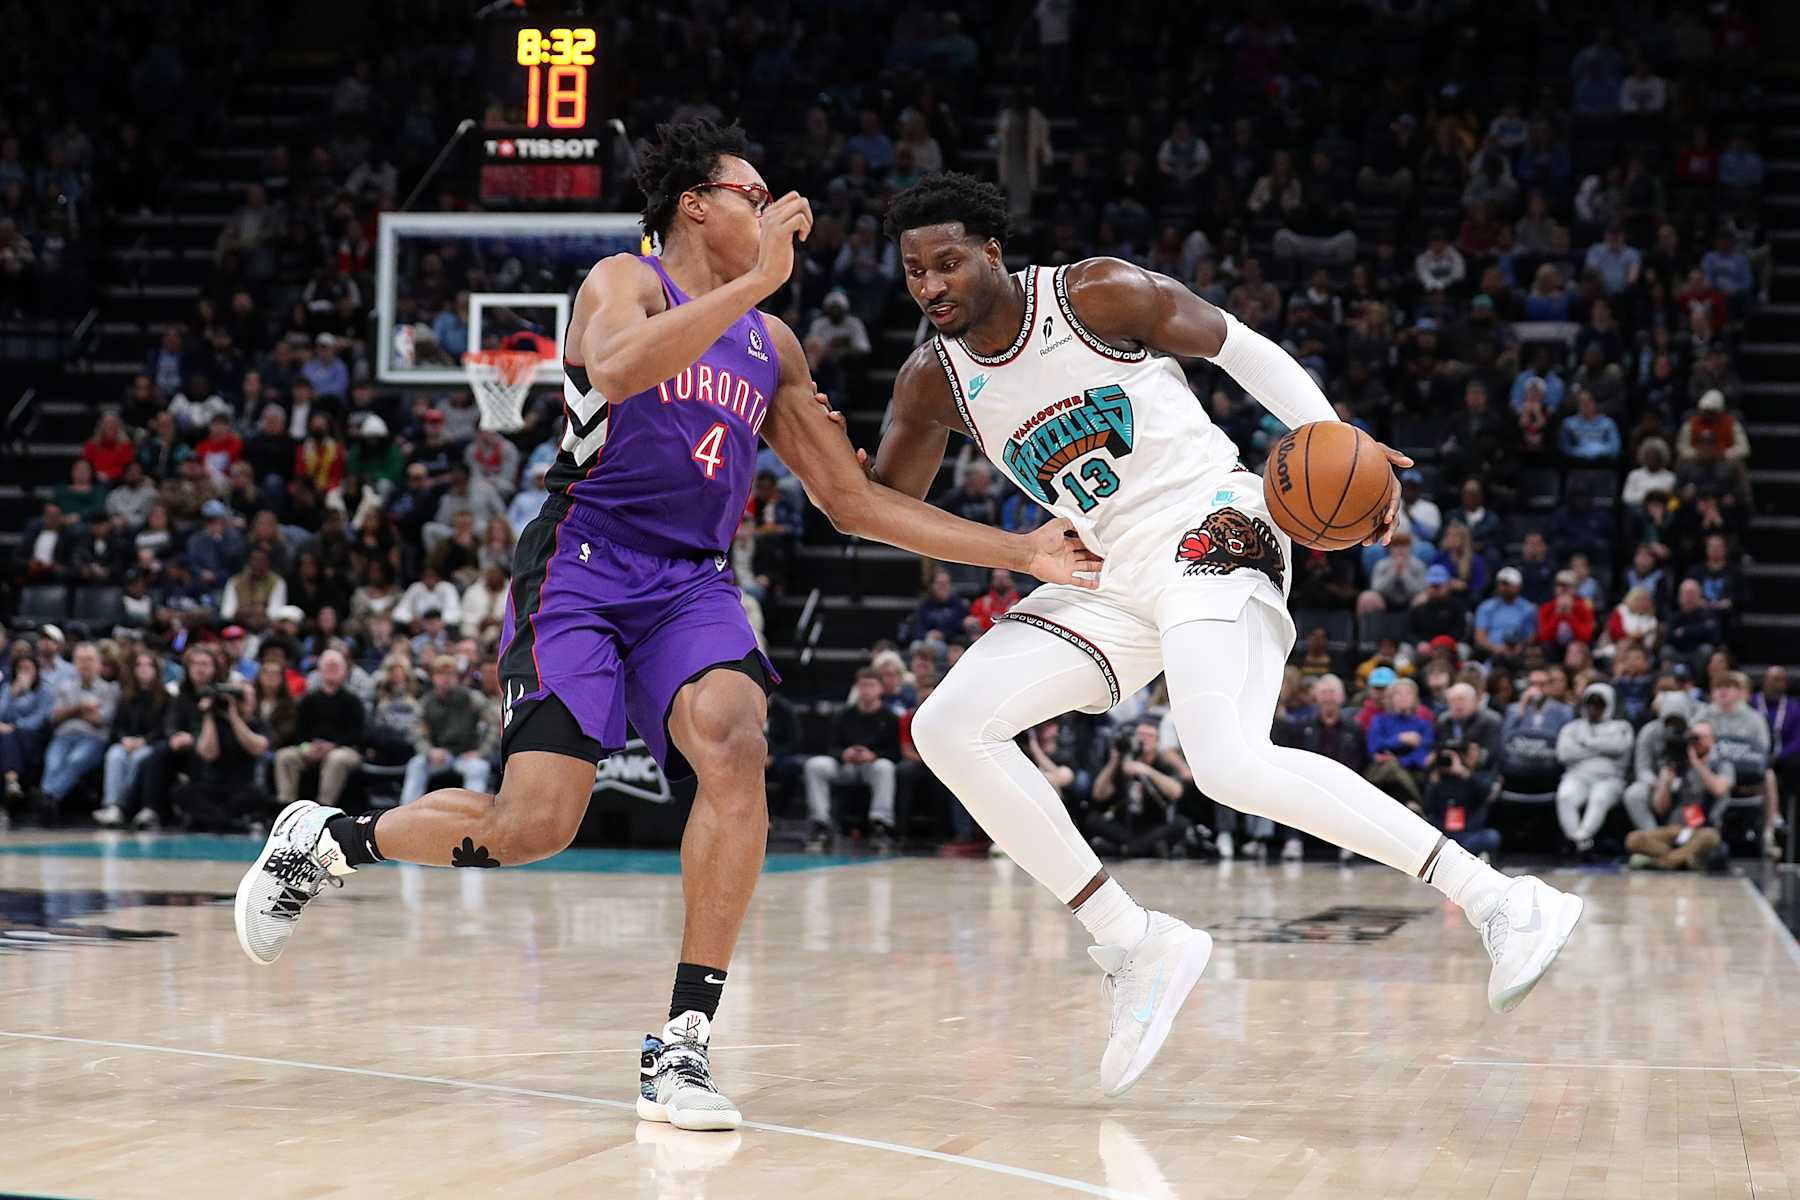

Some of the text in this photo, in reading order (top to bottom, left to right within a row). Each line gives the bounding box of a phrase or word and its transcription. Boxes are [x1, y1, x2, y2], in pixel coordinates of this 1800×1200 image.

[517, 28, 597, 66] 8:32
[526, 64, 588, 129] 18
[516, 138, 600, 158] TISSOT
[1040, 334, 1073, 358] Robinhood
[1013, 395, 1083, 442] VANCOUVER
[692, 422, 728, 480] 4
[1002, 384, 1134, 506] GRIZZLIES
[1062, 457, 1121, 514] 13
[597, 754, 657, 782] ONIC
